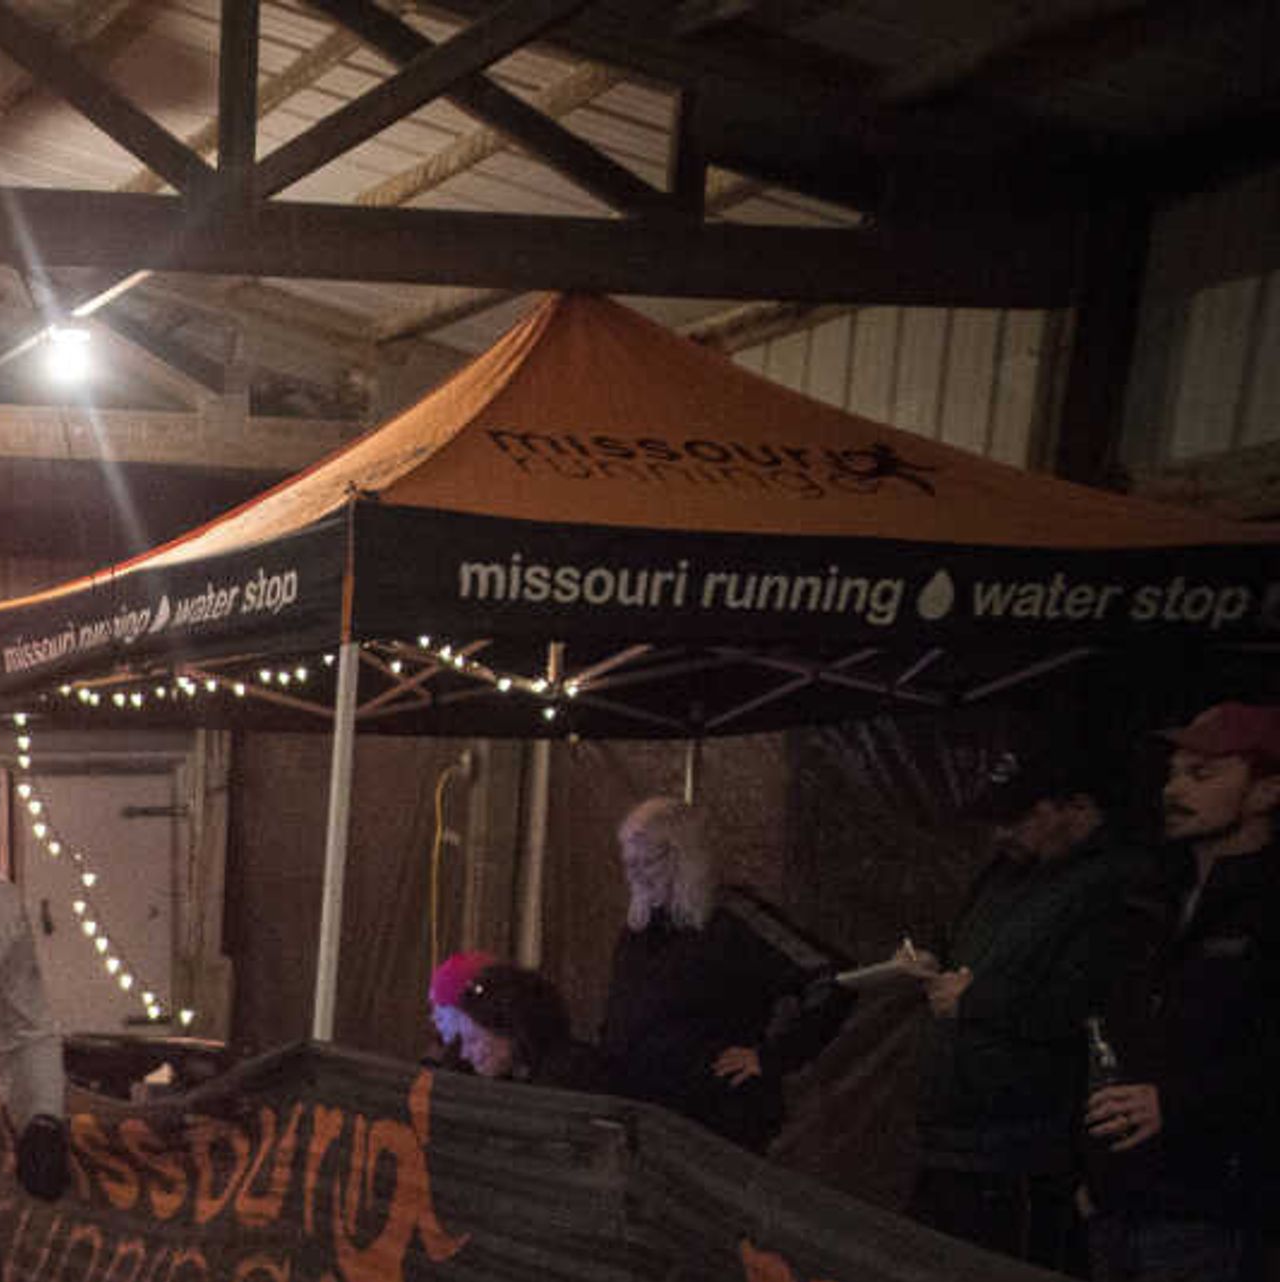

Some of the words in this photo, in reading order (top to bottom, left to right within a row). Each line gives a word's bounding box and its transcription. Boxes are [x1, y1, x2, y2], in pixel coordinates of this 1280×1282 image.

[2, 621, 76, 674] missouri
[173, 582, 241, 627] water
[240, 567, 299, 616] stop
[458, 551, 690, 608] missouri
[700, 565, 906, 627] running
[972, 571, 1124, 622] water
[1128, 574, 1249, 631] stop
